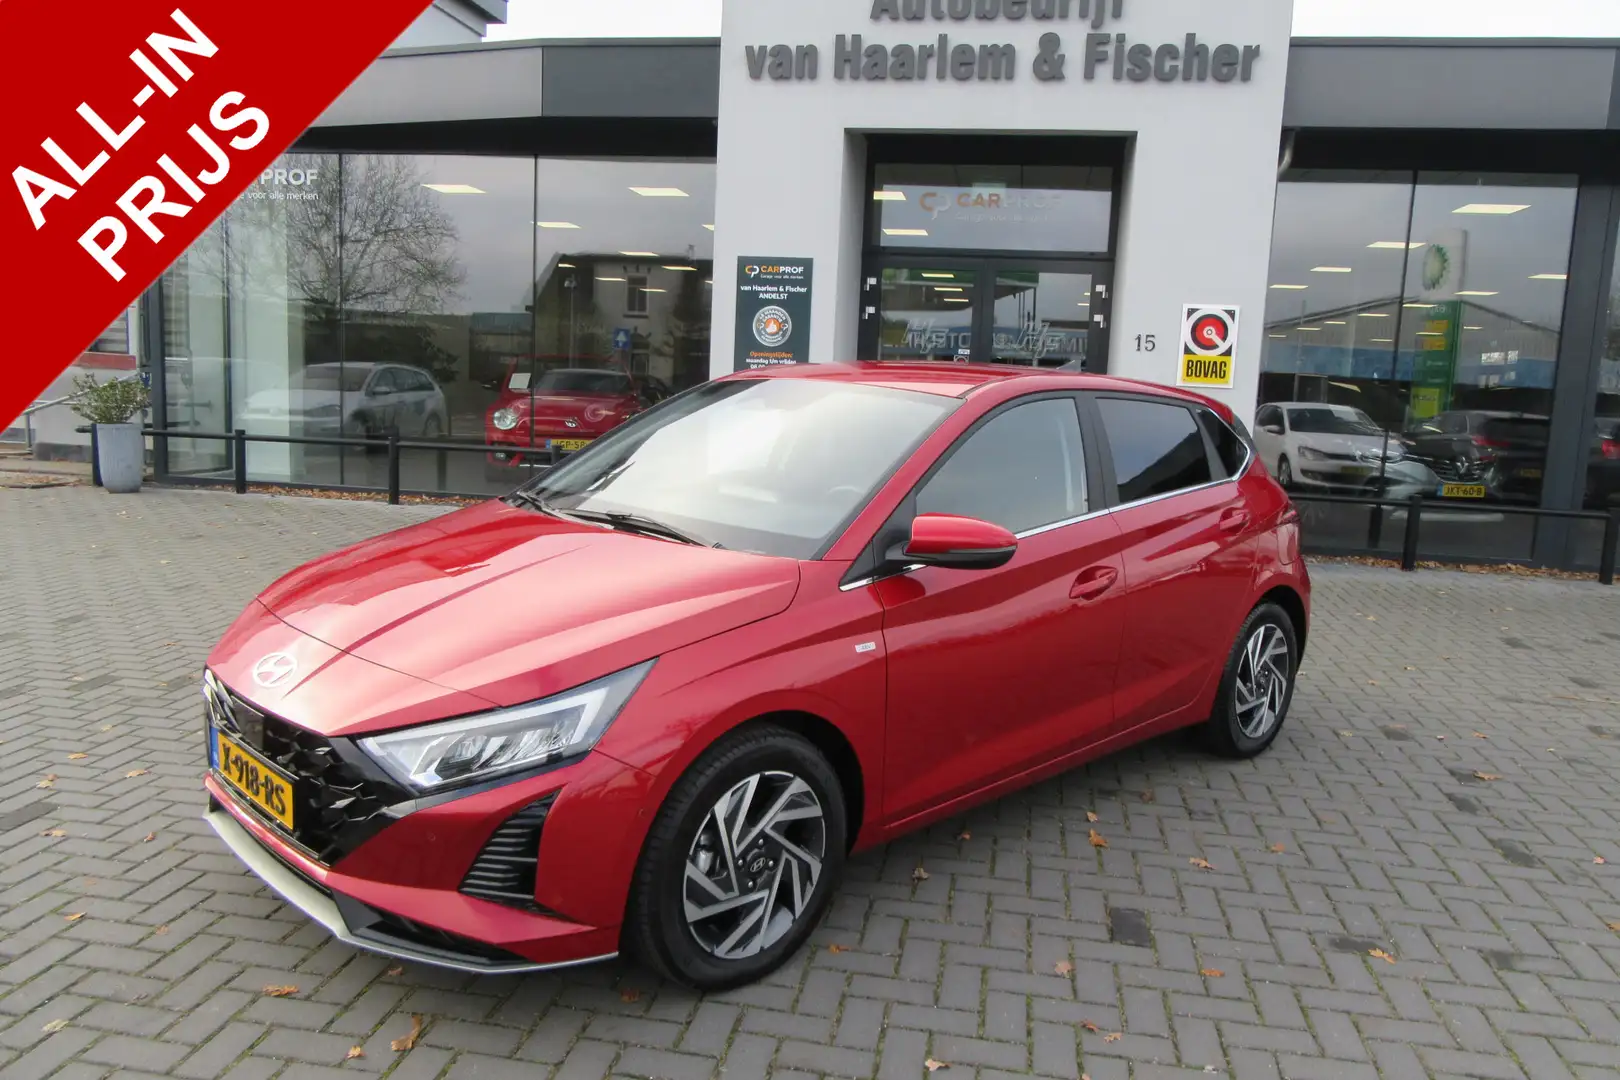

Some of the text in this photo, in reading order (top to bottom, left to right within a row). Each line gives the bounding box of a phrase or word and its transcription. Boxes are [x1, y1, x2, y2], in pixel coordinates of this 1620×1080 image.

[744, 31, 1261, 82] van Haarlem & Fischer
[260, 168, 318, 185] PROF
[269, 190, 285, 199] alle
[286, 191, 319, 200] merken
[760, 265, 804, 274] CARPROF
[752, 284, 777, 292] Haarlem
[1134, 333, 1157, 352] 15
[1185, 359, 1227, 379] BOVAG
[222, 742, 286, 816] X-918-RS
